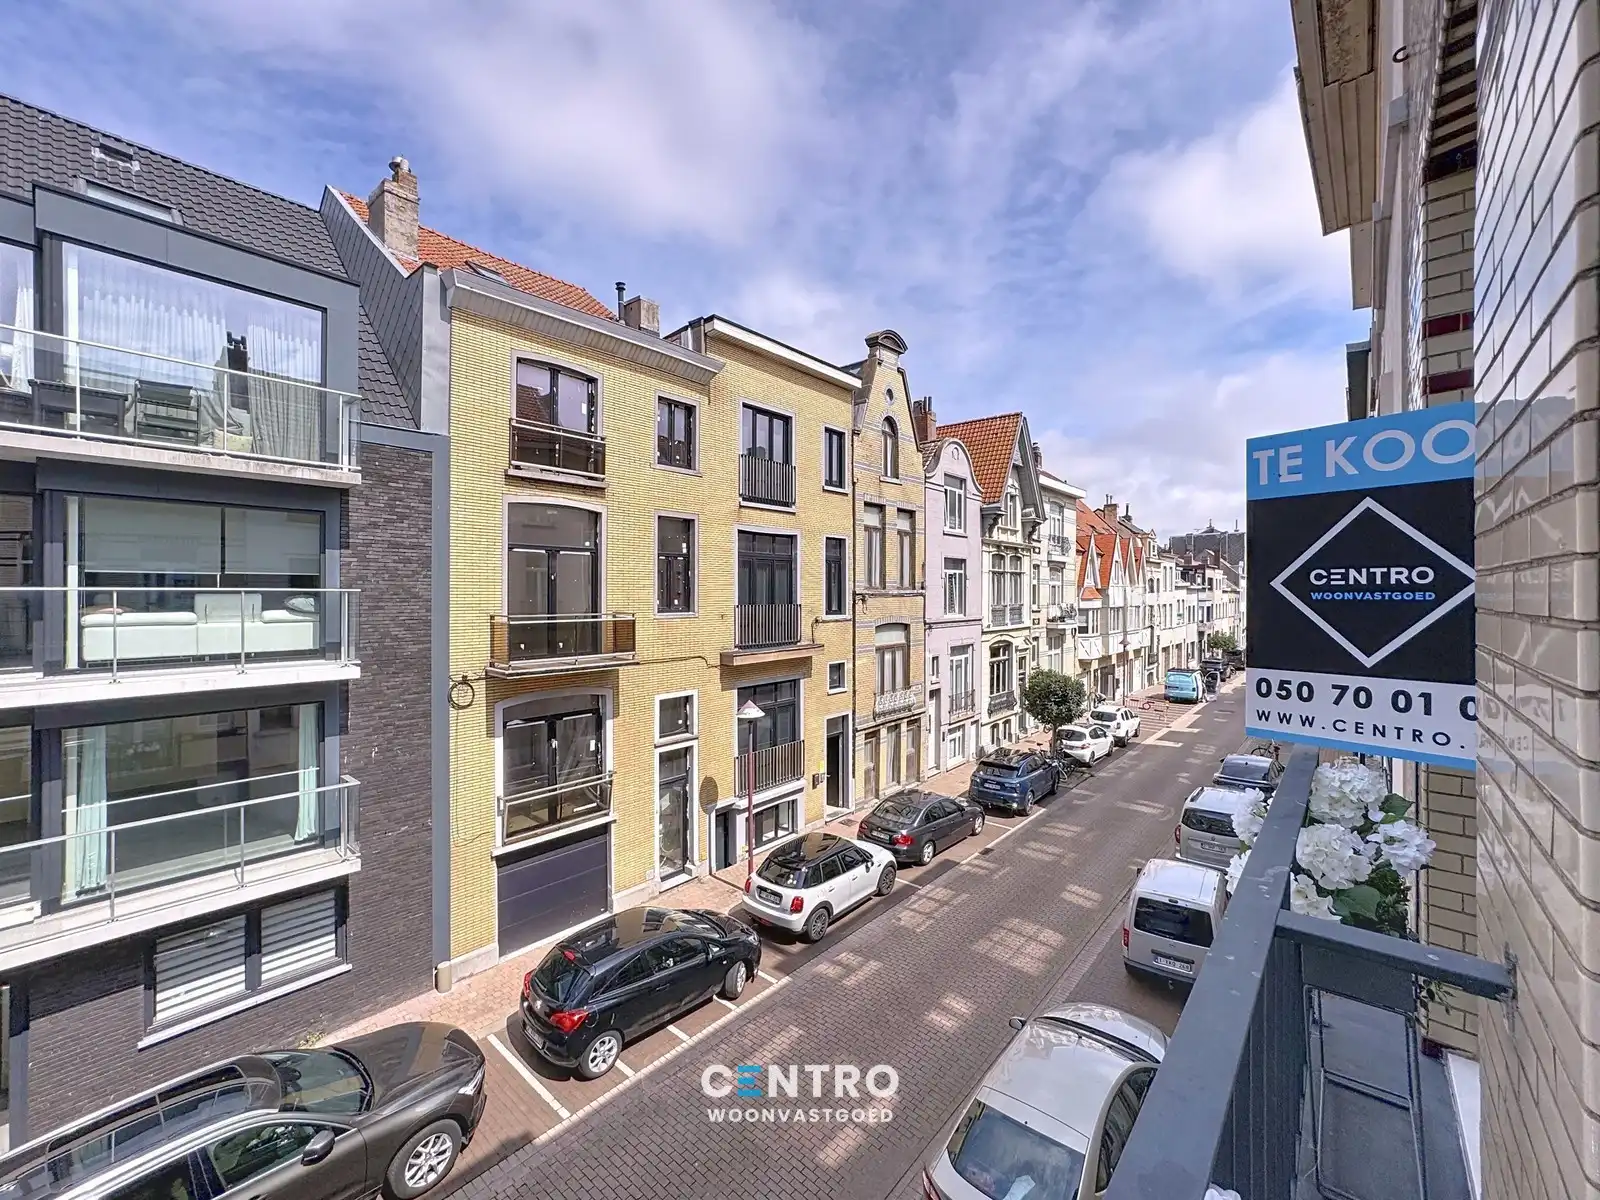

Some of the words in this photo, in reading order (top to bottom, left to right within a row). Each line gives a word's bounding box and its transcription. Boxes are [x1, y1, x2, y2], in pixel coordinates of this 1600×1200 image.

[1253, 445, 1302, 485] TE
[1310, 566, 1435, 585] CENTRO
[1310, 592, 1436, 600] WOONVASTGOED
[1255, 677, 1314, 702] 050
[1331, 683, 1373, 709] 70
[1391, 689, 1433, 716] 01
